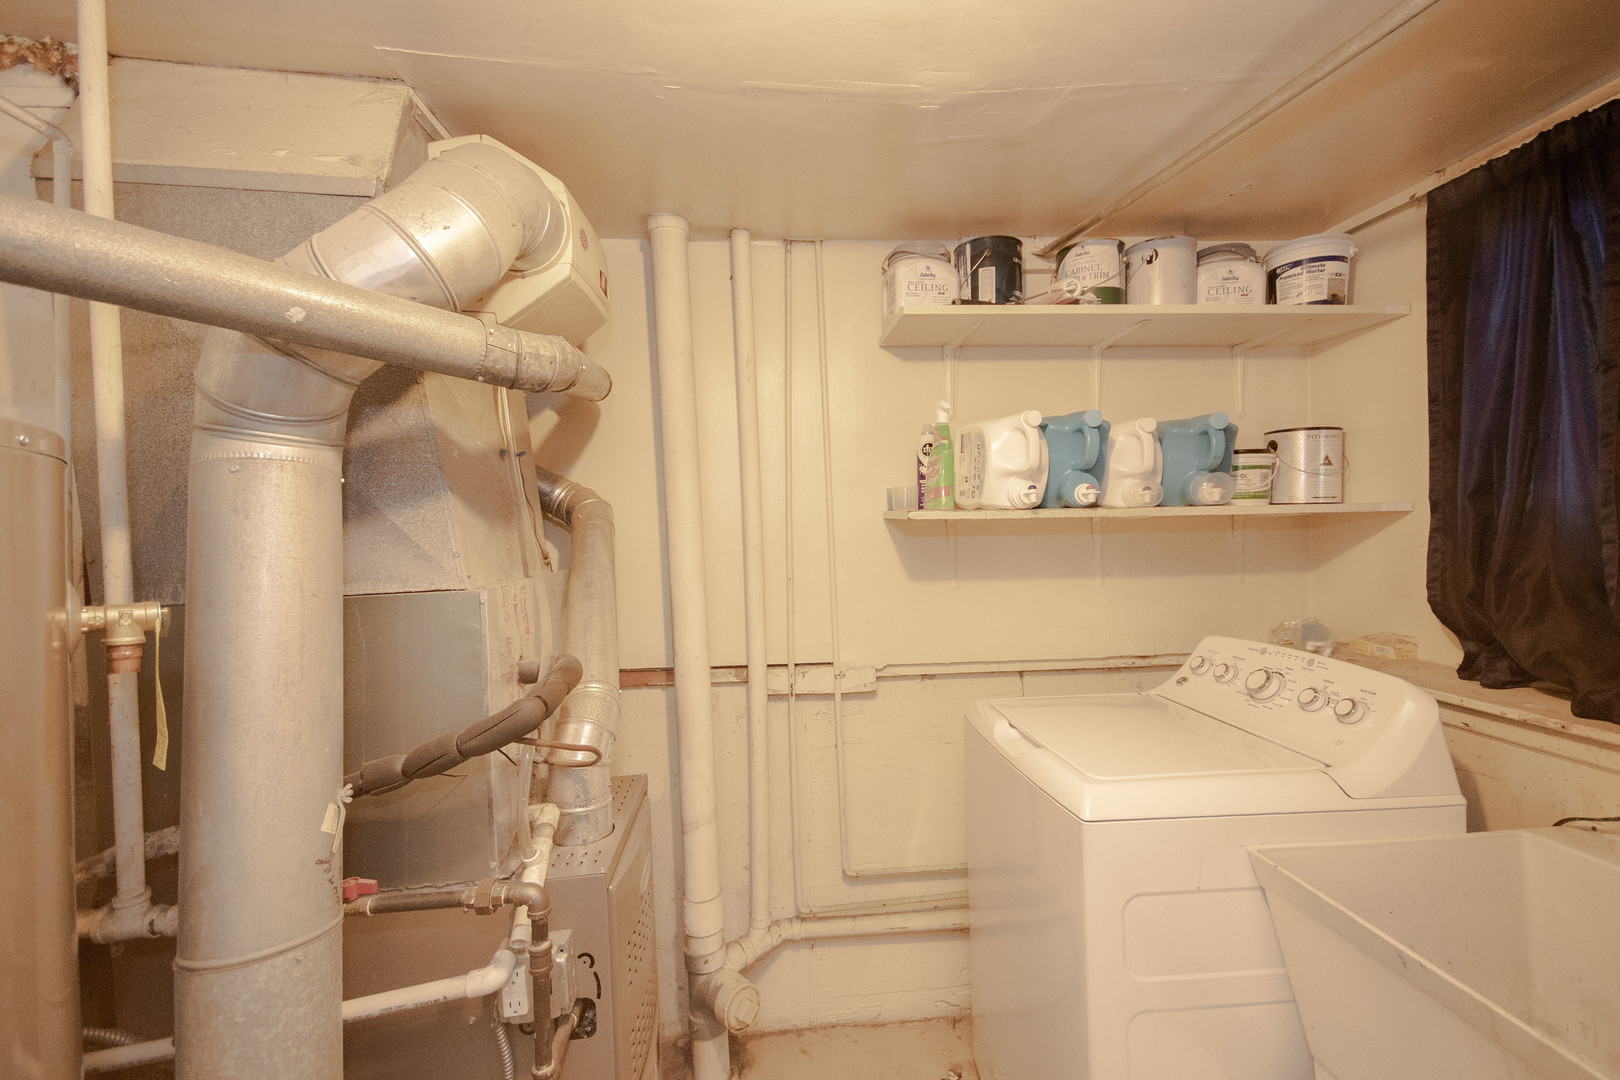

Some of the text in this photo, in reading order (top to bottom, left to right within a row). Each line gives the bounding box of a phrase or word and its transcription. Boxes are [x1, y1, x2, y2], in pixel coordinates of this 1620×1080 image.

[1065, 263, 1103, 277] CABINET,
[1087, 271, 1110, 280] TRIM
[907, 283, 949, 292] CEILING
[1207, 285, 1253, 296] CEILING
